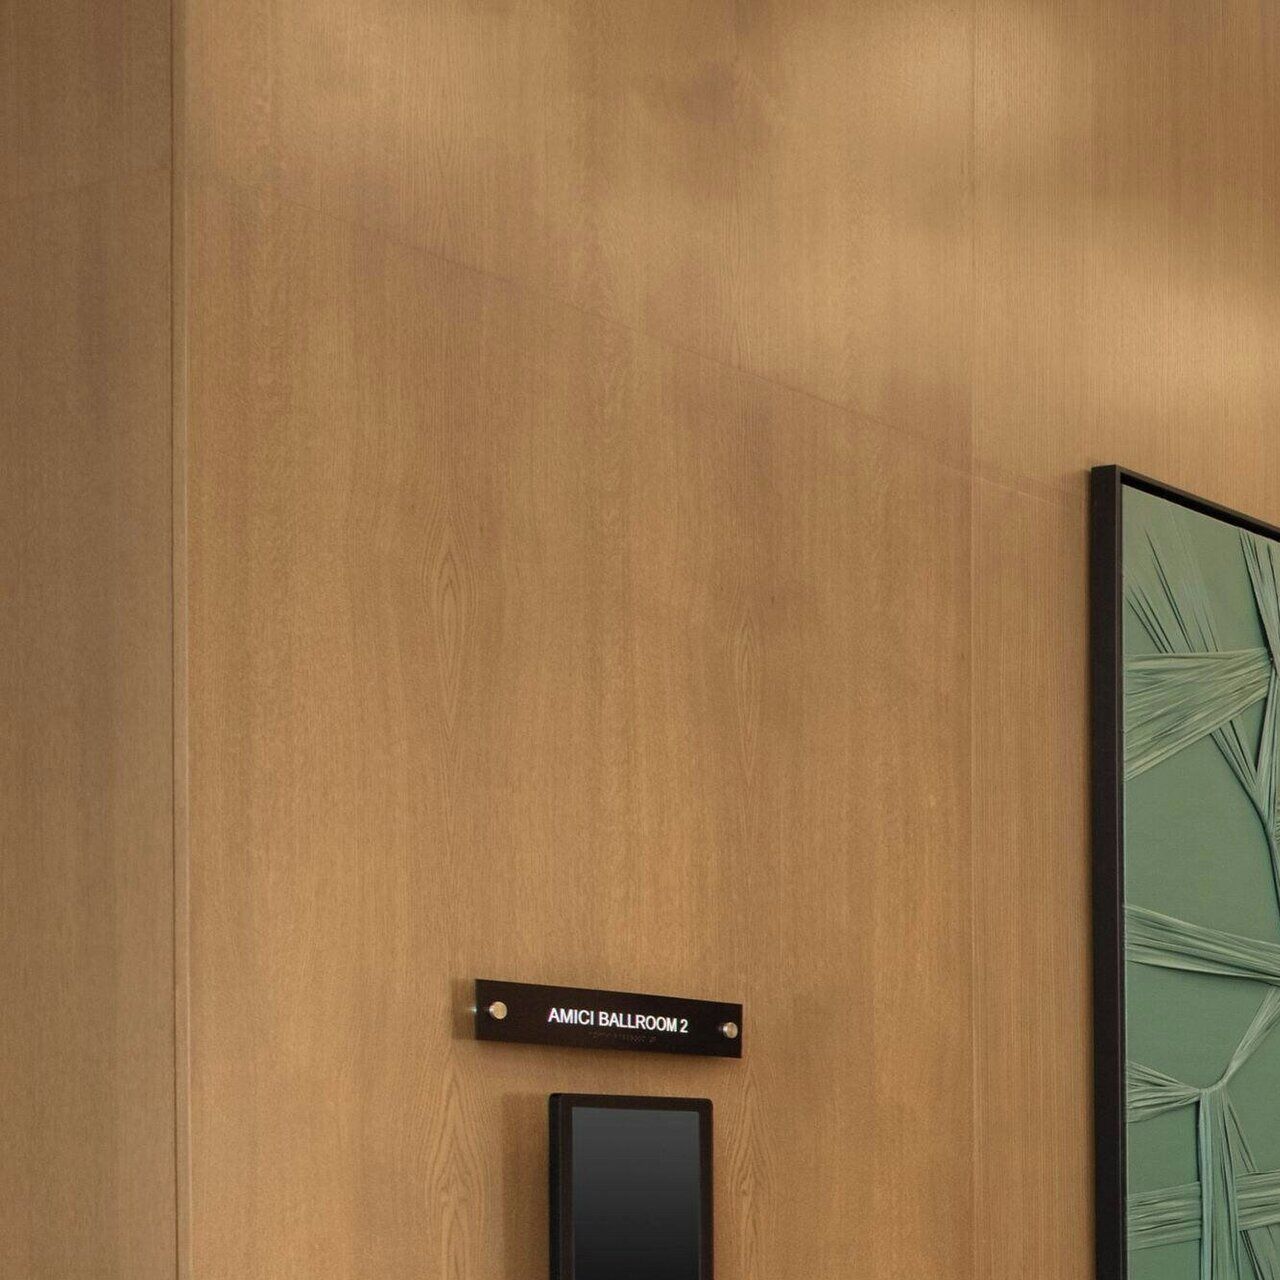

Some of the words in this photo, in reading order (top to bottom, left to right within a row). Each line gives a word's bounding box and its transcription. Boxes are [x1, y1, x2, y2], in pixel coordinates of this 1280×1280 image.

[548, 1007, 595, 1026] AMICI
[598, 1011, 678, 1033] BALLROOM
[679, 1018, 689, 1034] 2
